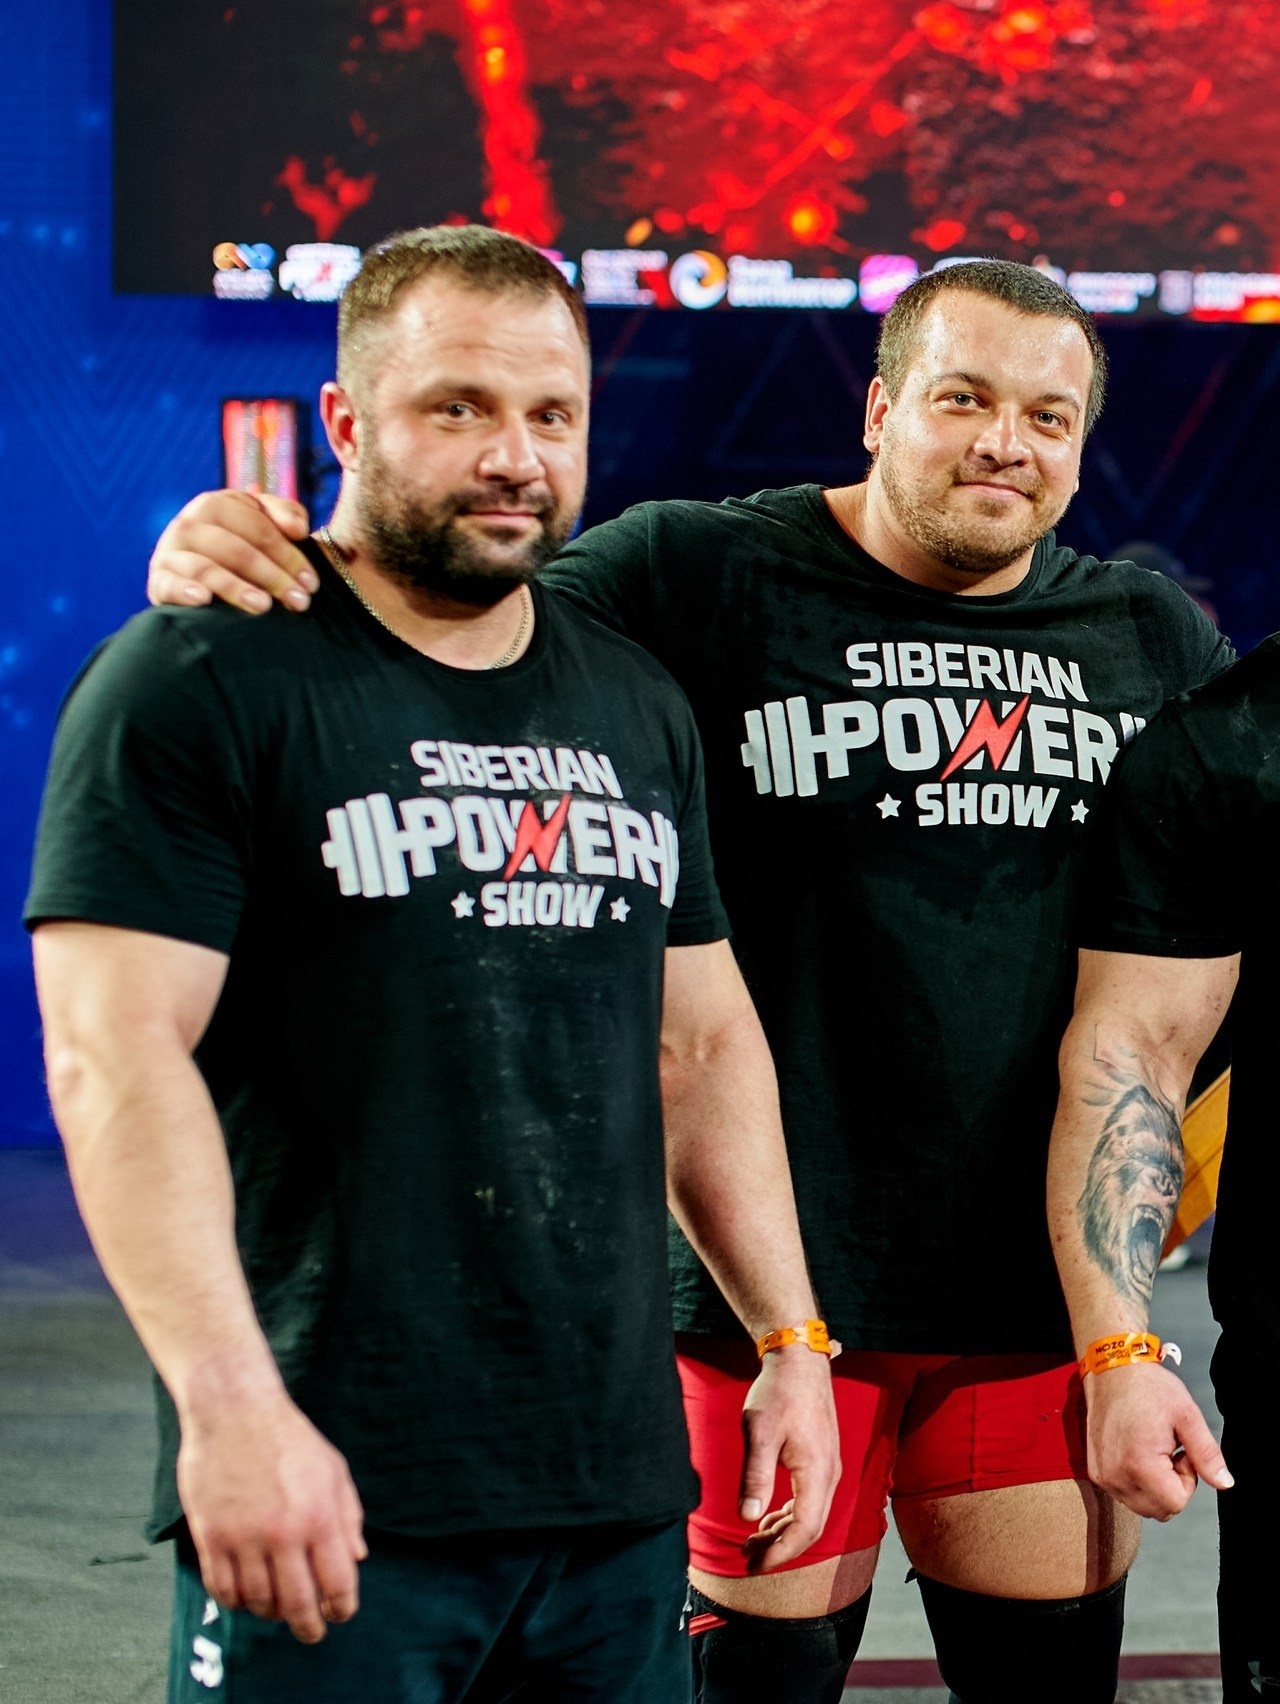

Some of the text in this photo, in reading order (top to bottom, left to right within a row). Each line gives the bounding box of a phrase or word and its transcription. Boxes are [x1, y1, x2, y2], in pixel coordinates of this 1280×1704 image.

[846, 642, 1090, 702] SIBERIAN
[411, 739, 624, 799] SIBERIAN
[822, 696, 1120, 785] POWER
[915, 782, 1060, 828] SHOW
[398, 793, 660, 887] POWER
[480, 881, 605, 928] SHOW
[1095, 1340, 1125, 1355] OZON
